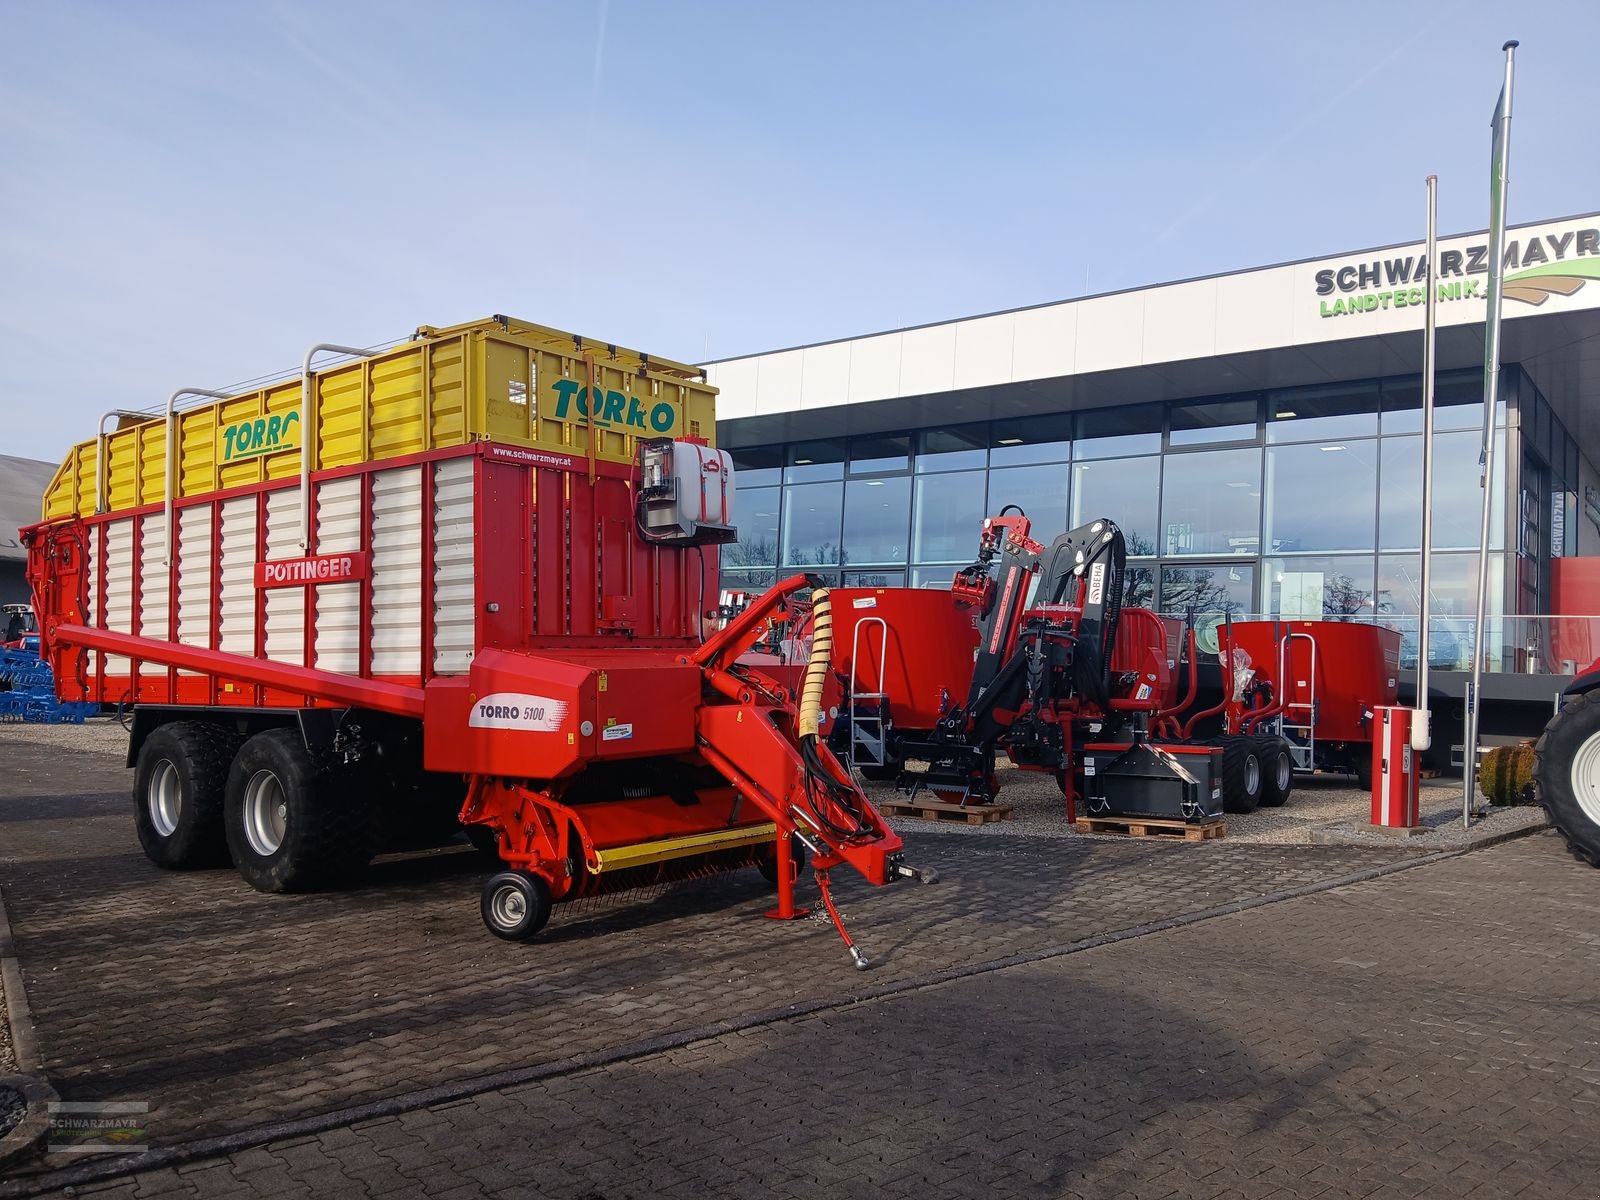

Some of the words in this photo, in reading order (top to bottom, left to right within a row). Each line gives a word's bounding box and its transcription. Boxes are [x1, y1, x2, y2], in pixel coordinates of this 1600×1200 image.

[493, 447, 571, 466] www.schwarzmayr.at
[1093, 564, 1103, 588] BEHA
[480, 705, 519, 719] TORRO
[523, 707, 545, 721] 5100
